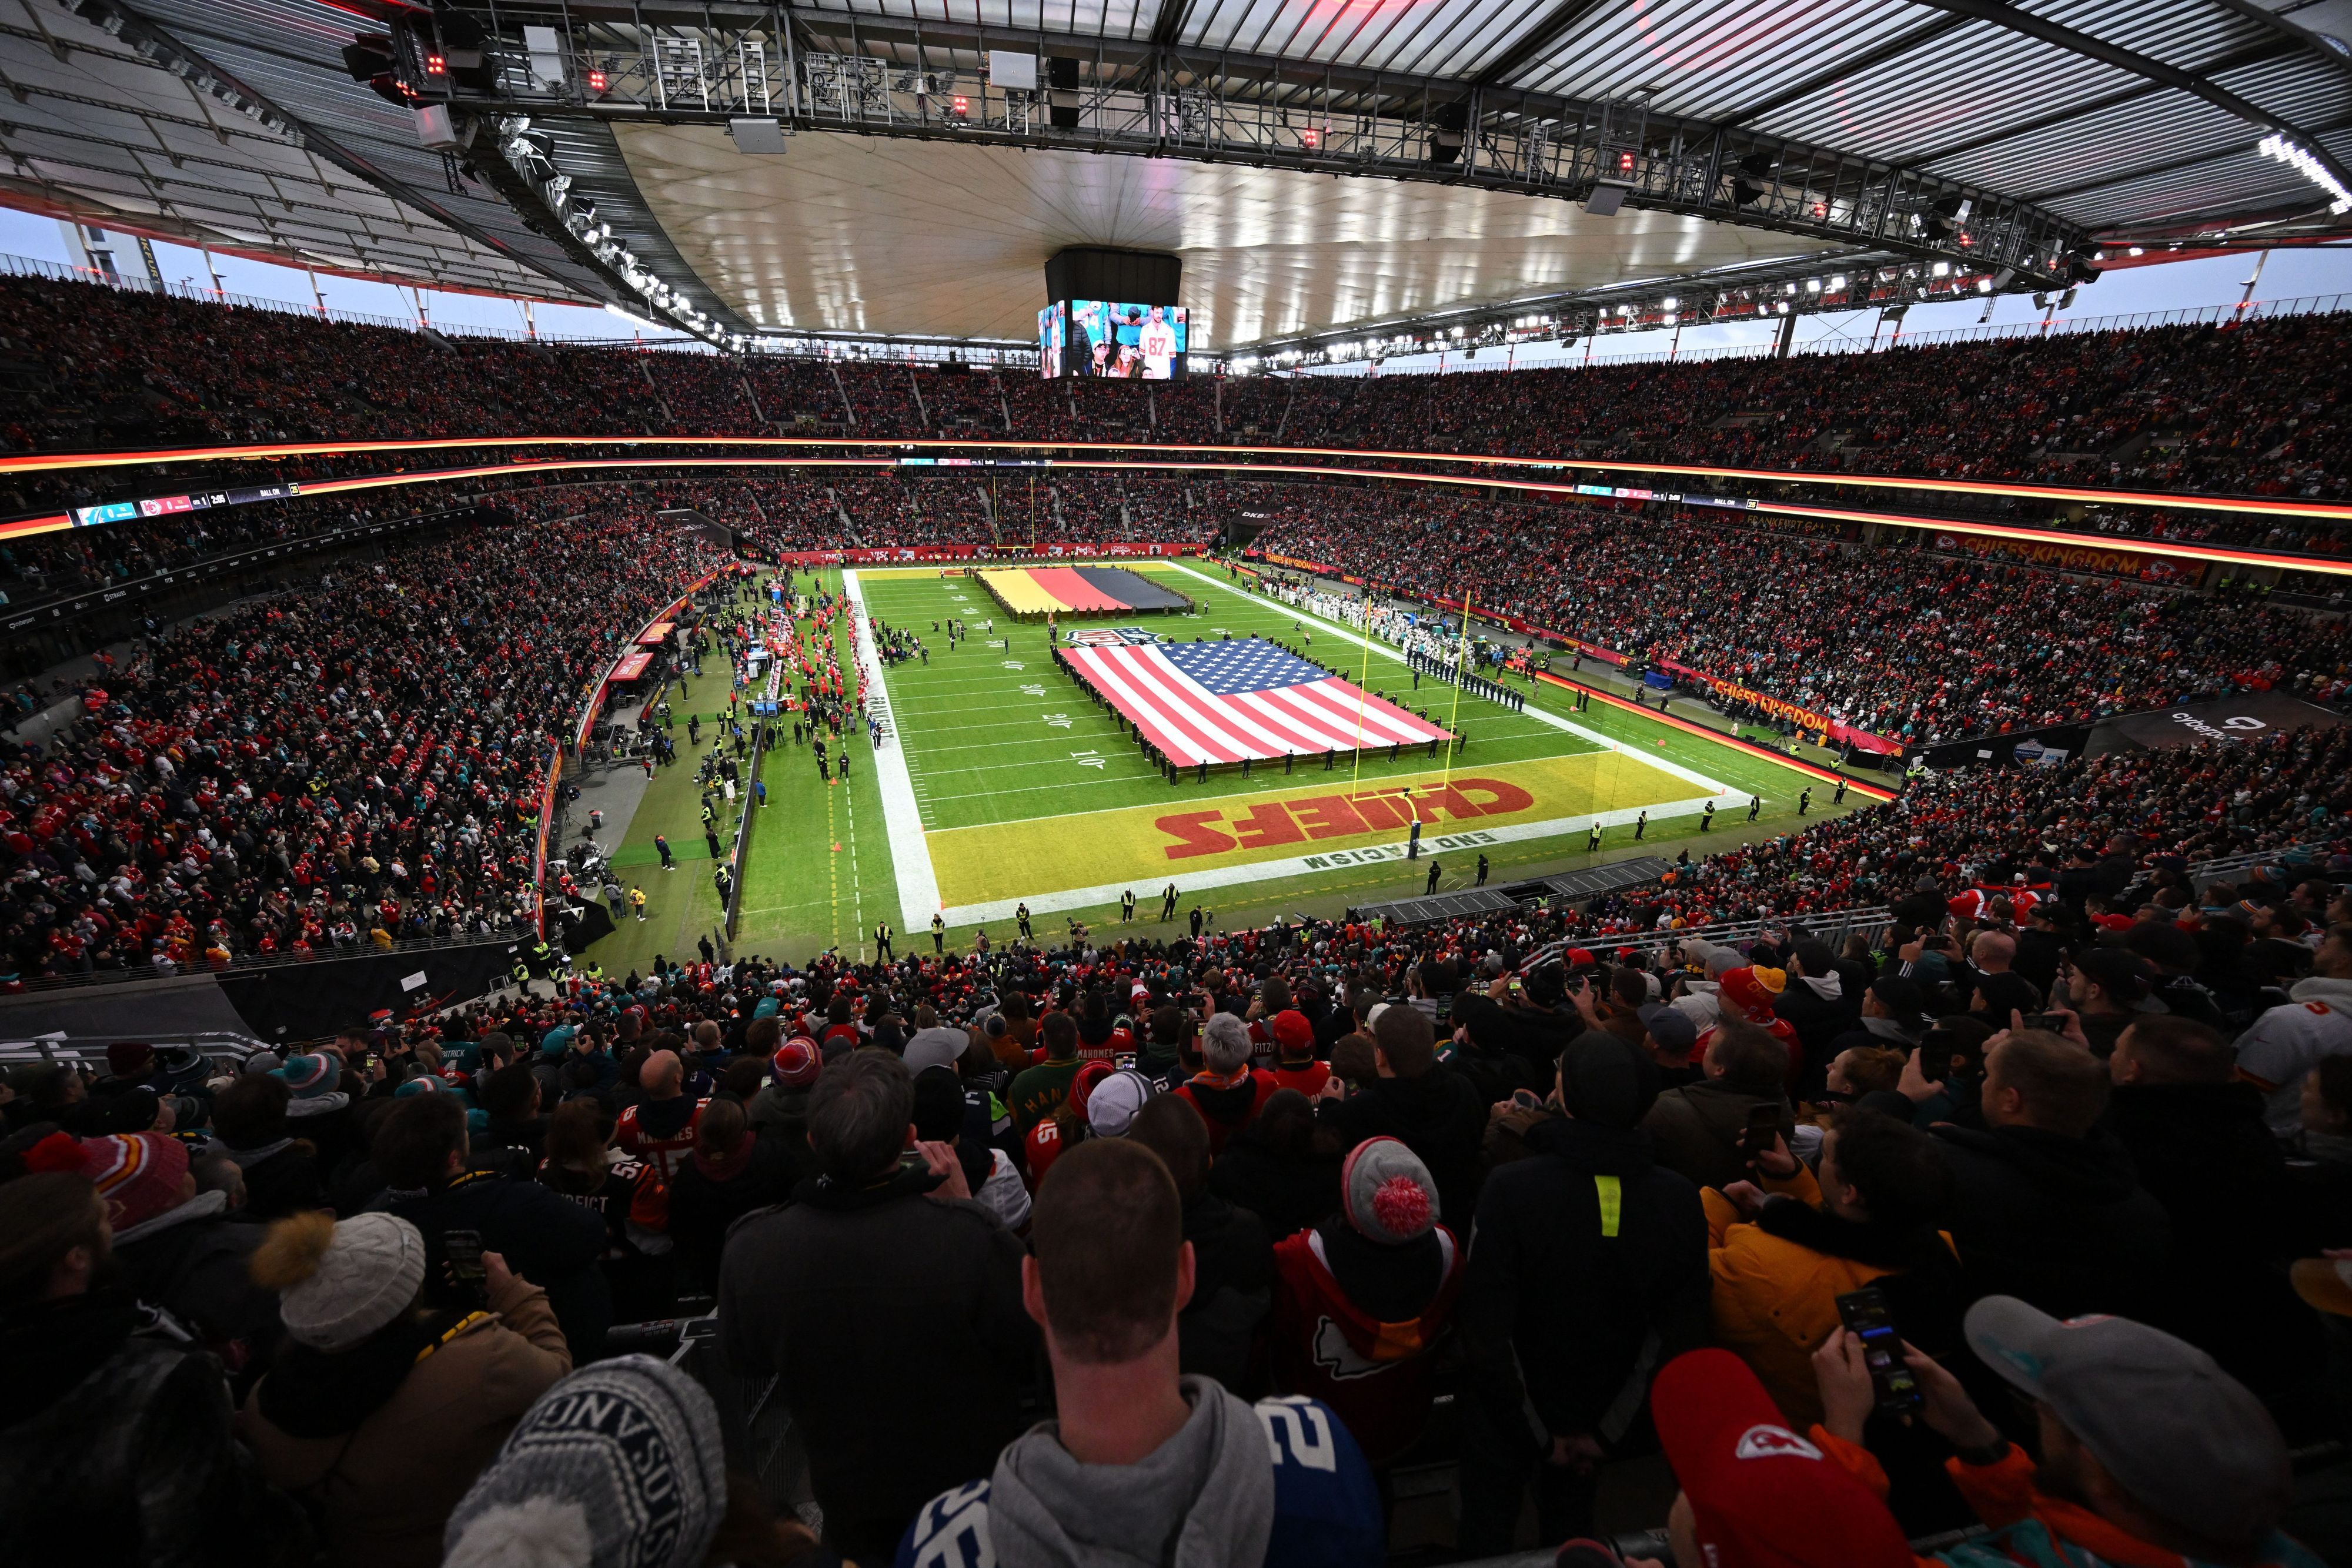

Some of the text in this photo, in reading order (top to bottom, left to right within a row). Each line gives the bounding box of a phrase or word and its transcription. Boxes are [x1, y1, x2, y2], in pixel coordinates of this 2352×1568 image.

[1148, 337, 1167, 356] 87
[290, 486, 299, 494] 25
[201, 497, 207, 506] 1
[211, 494, 226, 504] 2:05
[1266, 554, 1284, 564] CHIEFS
[1285, 557, 1311, 570] KINGDOM
[2030, 544, 2140, 574] KINGDOM
[109, 590, 126, 600] STRAUSS
[15, 617, 35, 627] cyberport
[1453, 608, 1474, 618] FRANKURT
[1474, 614, 1487, 623] GAMES
[1077, 630, 1125, 646] NFL
[1001, 660, 1025, 669] 40
[1020, 684, 1047, 694] 30
[1715, 680, 1829, 735] CHIEFS KINGDOM
[868, 697, 894, 738] FRANKFURT
[1042, 713, 1073, 726] 20
[1070, 750, 1105, 765] 10
[1155, 778, 1534, 860] CHIEFS
[1435, 831, 1498, 848] END
[442, 1049, 465, 1058] PATRICK
[1077, 1048, 1114, 1059] MAHOMES
[1152, 1076, 1170, 1094] 12
[1037, 1122, 1058, 1145] 15
